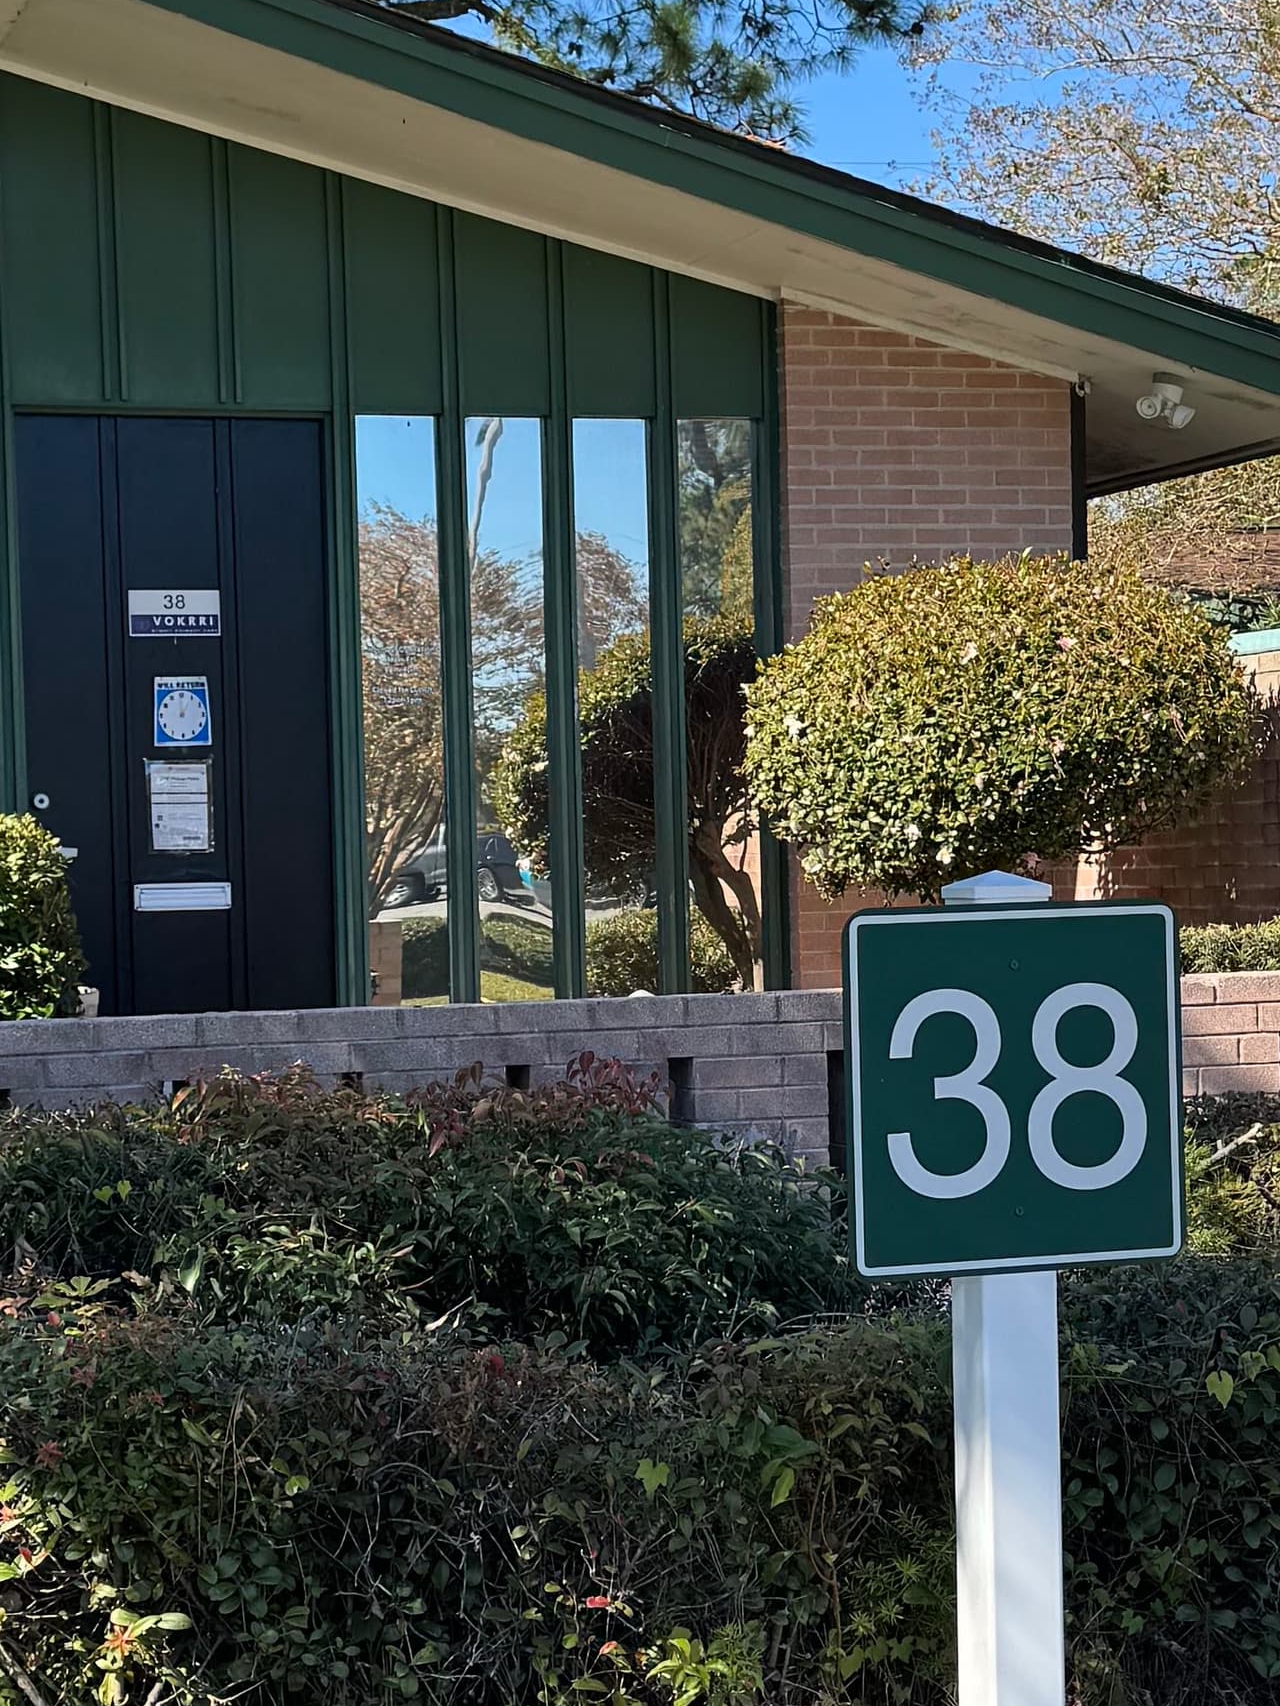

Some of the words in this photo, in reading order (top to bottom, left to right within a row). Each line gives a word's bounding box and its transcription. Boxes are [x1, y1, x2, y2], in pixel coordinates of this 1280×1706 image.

[163, 594, 186, 610] 38
[152, 615, 214, 627] VOKRRI
[886, 981, 1148, 1199] 38
